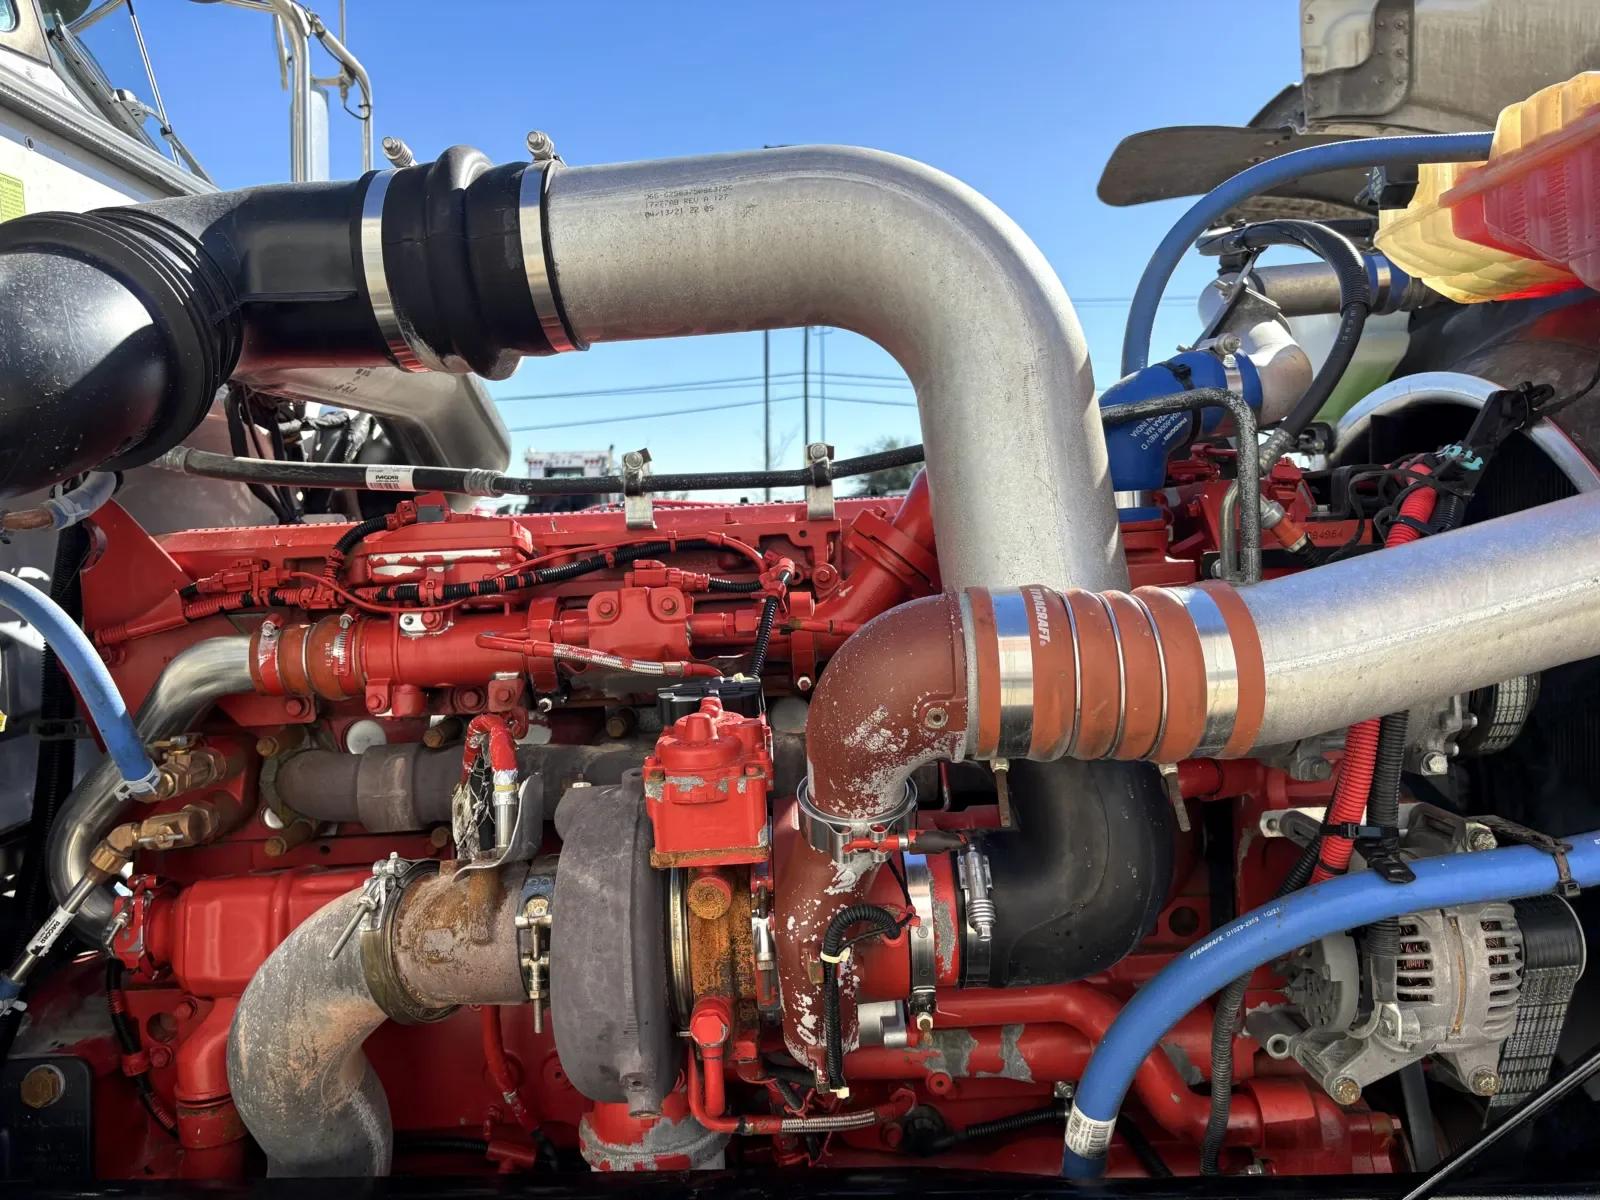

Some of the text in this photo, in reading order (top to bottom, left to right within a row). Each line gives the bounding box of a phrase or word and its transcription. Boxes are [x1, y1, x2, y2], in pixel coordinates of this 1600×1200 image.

[683, 197, 699, 205] REV
[703, 195, 709, 203] A
[1129, 420, 1149, 438] INDIA
[1146, 432, 1160, 446] REV
